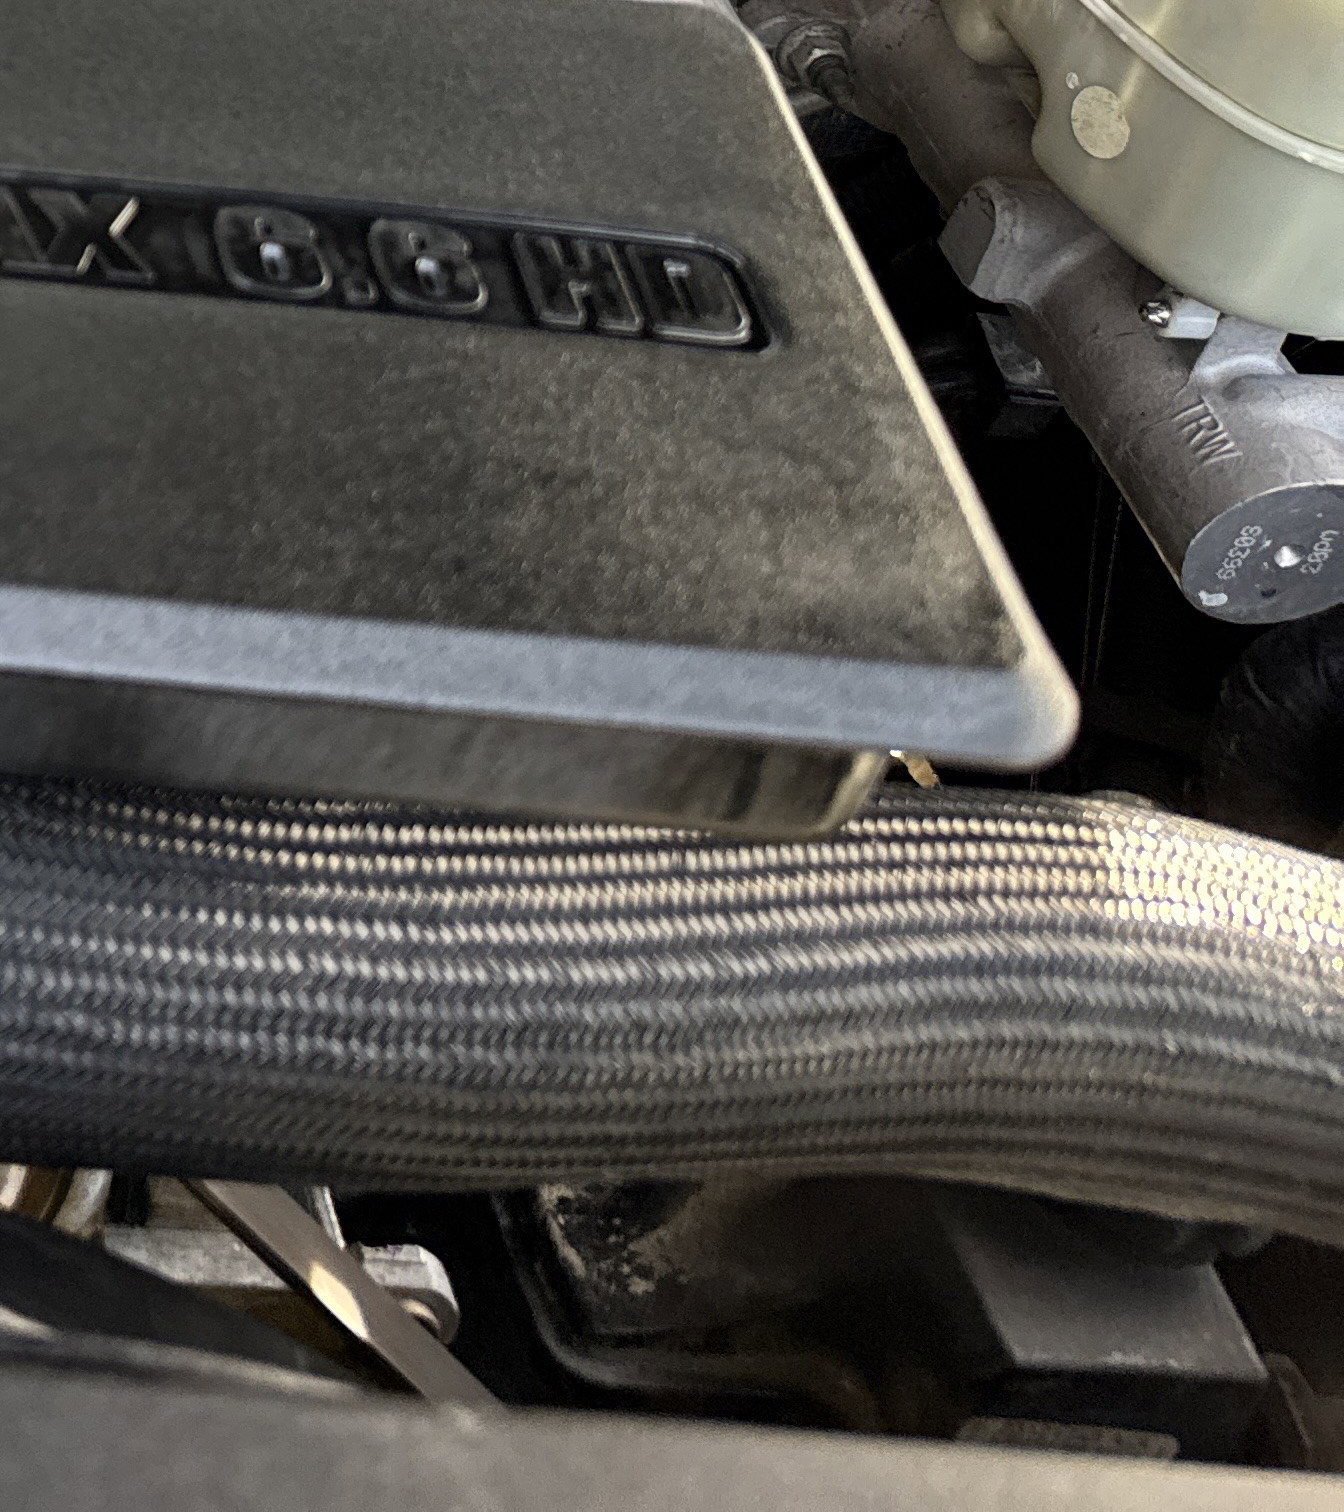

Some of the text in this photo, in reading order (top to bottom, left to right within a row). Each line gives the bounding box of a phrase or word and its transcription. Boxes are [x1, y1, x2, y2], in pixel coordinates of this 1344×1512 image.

[214, 204, 490, 315] 6.6
[513, 230, 752, 346] HD
[1170, 394, 1244, 467] TRW
